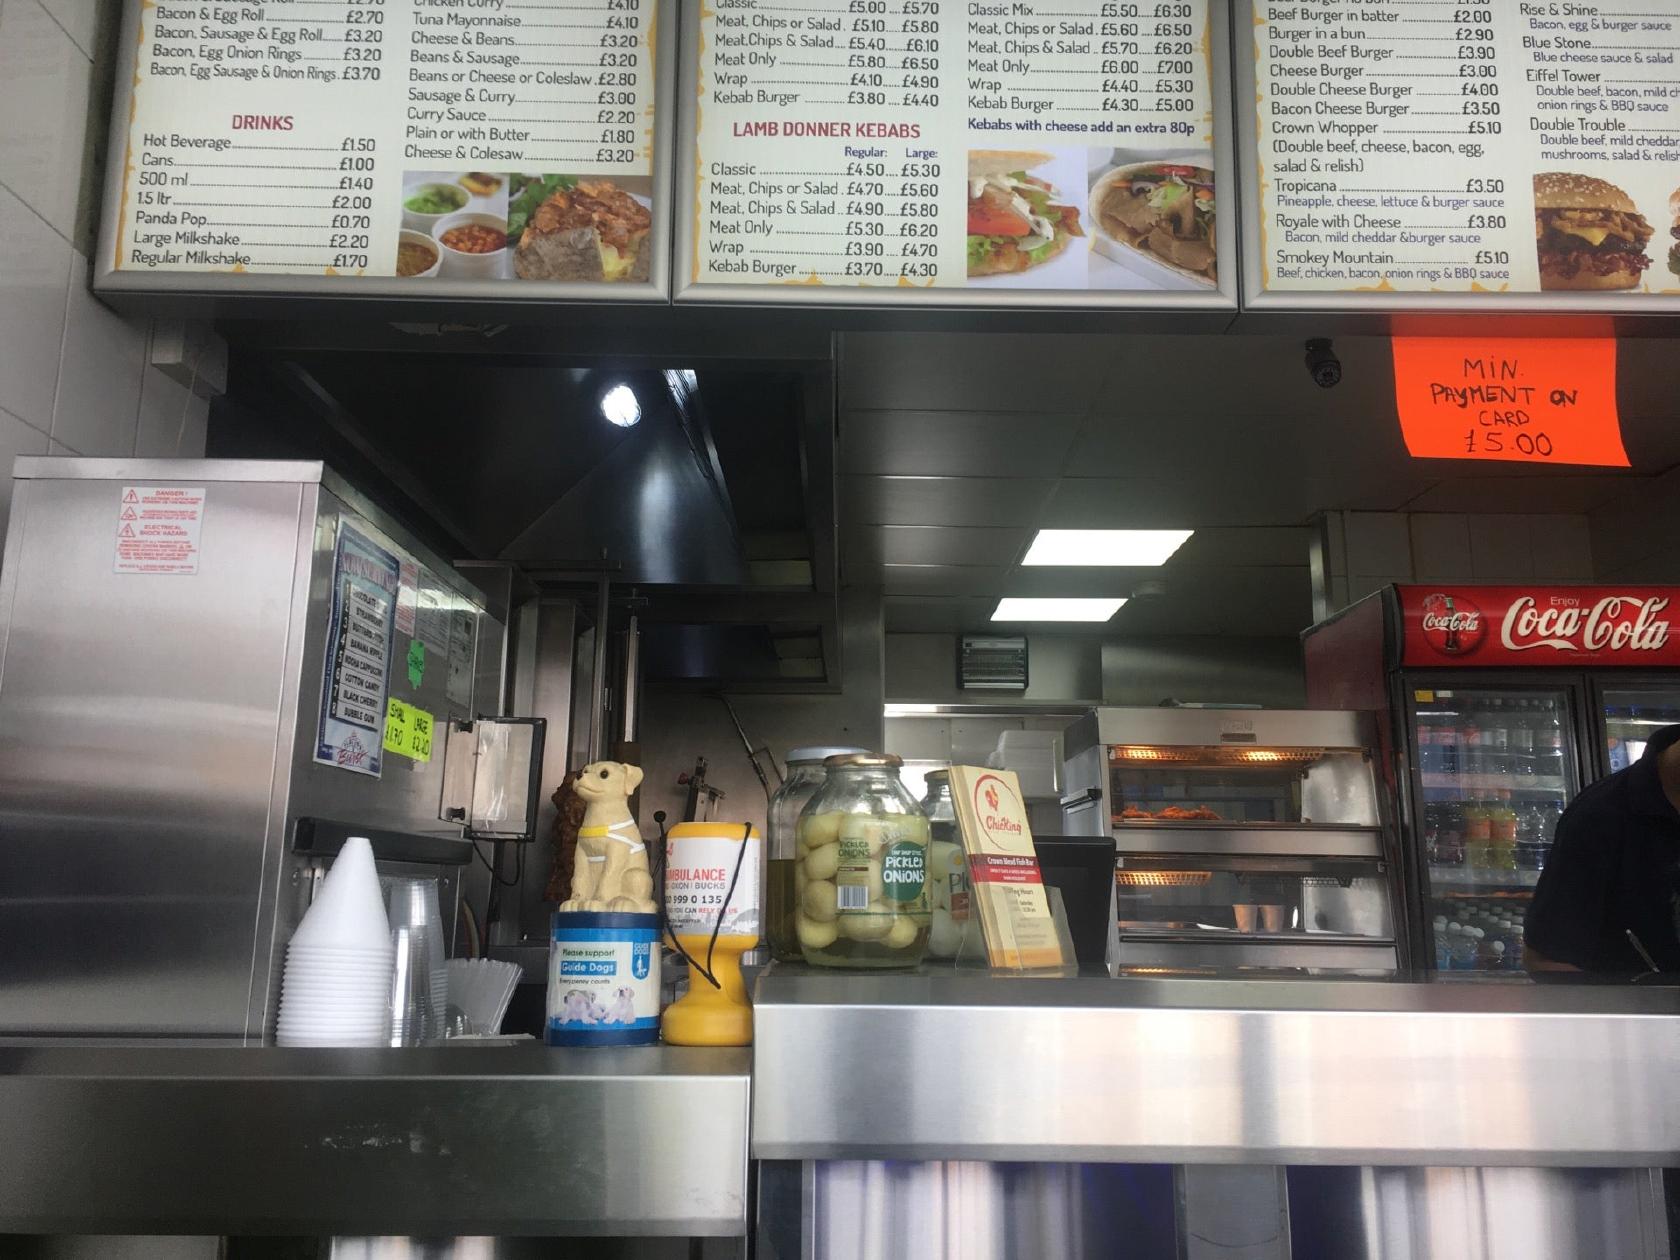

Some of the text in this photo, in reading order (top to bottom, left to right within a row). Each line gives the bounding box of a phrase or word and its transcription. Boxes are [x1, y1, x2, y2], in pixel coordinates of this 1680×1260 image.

[157, 7, 383, 24] Bacon & Egg Roll £2.70
[968, 3, 1191, 18] Classic Mix £5.50 £6.30
[1520, 3, 1598, 16] Rise & Shine
[413, 12, 638, 30] Tuna Mayonnaise £4.10
[1529, 18, 1672, 32] Bacon, egg & burger sauce
[411, 31, 638, 48] Cheese & Beans £3.20
[1522, 36, 1591, 49] Blue Stone
[1270, 63, 1496, 80] Cheese Burger £3.00
[1526, 69, 1601, 82] Eiffel Tower
[232, 115, 294, 131] DRINKS
[407, 107, 635, 124] Curry Sauce £2.20
[1530, 117, 1626, 131] Double Trouble
[406, 126, 634, 144] Plain or with Butter £1.80
[733, 122, 920, 138] LAMB DONNER KEBABS
[968, 118, 1195, 136] Kebabs with cheese add an extra 80p
[1272, 121, 1501, 138] Crown Whopper £5.10
[144, 134, 375, 152] Hot Beverage £1.50
[844, 146, 938, 160] Regular: Large:
[142, 153, 374, 171] Cans £1.00
[711, 163, 940, 178] Classic £4.50 £5.30
[139, 172, 373, 190] 500 ml £1.40
[749, 182, 783, 197] Chips
[787, 185, 800, 195] or
[804, 182, 838, 196] Salad
[846, 183, 883, 197] £4.70
[900, 184, 938, 197] £5.60
[1274, 178, 1504, 193] Tropicana £3.50
[1277, 195, 1504, 210] Pineapple, cheese, lettuce & burger sauce
[136, 211, 370, 229] Panda Pop £0.70
[709, 220, 938, 237] Meat Only £5.30 £6.20
[134, 230, 368, 249] Large Milkshake £2.20
[131, 250, 368, 268] Regular Milkshake £1.70
[1276, 250, 1509, 267] Smokey Mountain £5.10
[709, 260, 937, 277] Kebab Burger £3.70 £4.30
[1479, 410, 1529, 427] CARD
[1465, 429, 1552, 456] £5.00
[1550, 596, 1580, 607] Enjoy
[1501, 595, 1669, 651] Coca-Cola
[702, 895, 722, 904] 135
[562, 948, 615, 958] Please support
[562, 962, 614, 974] Guide Dogs
